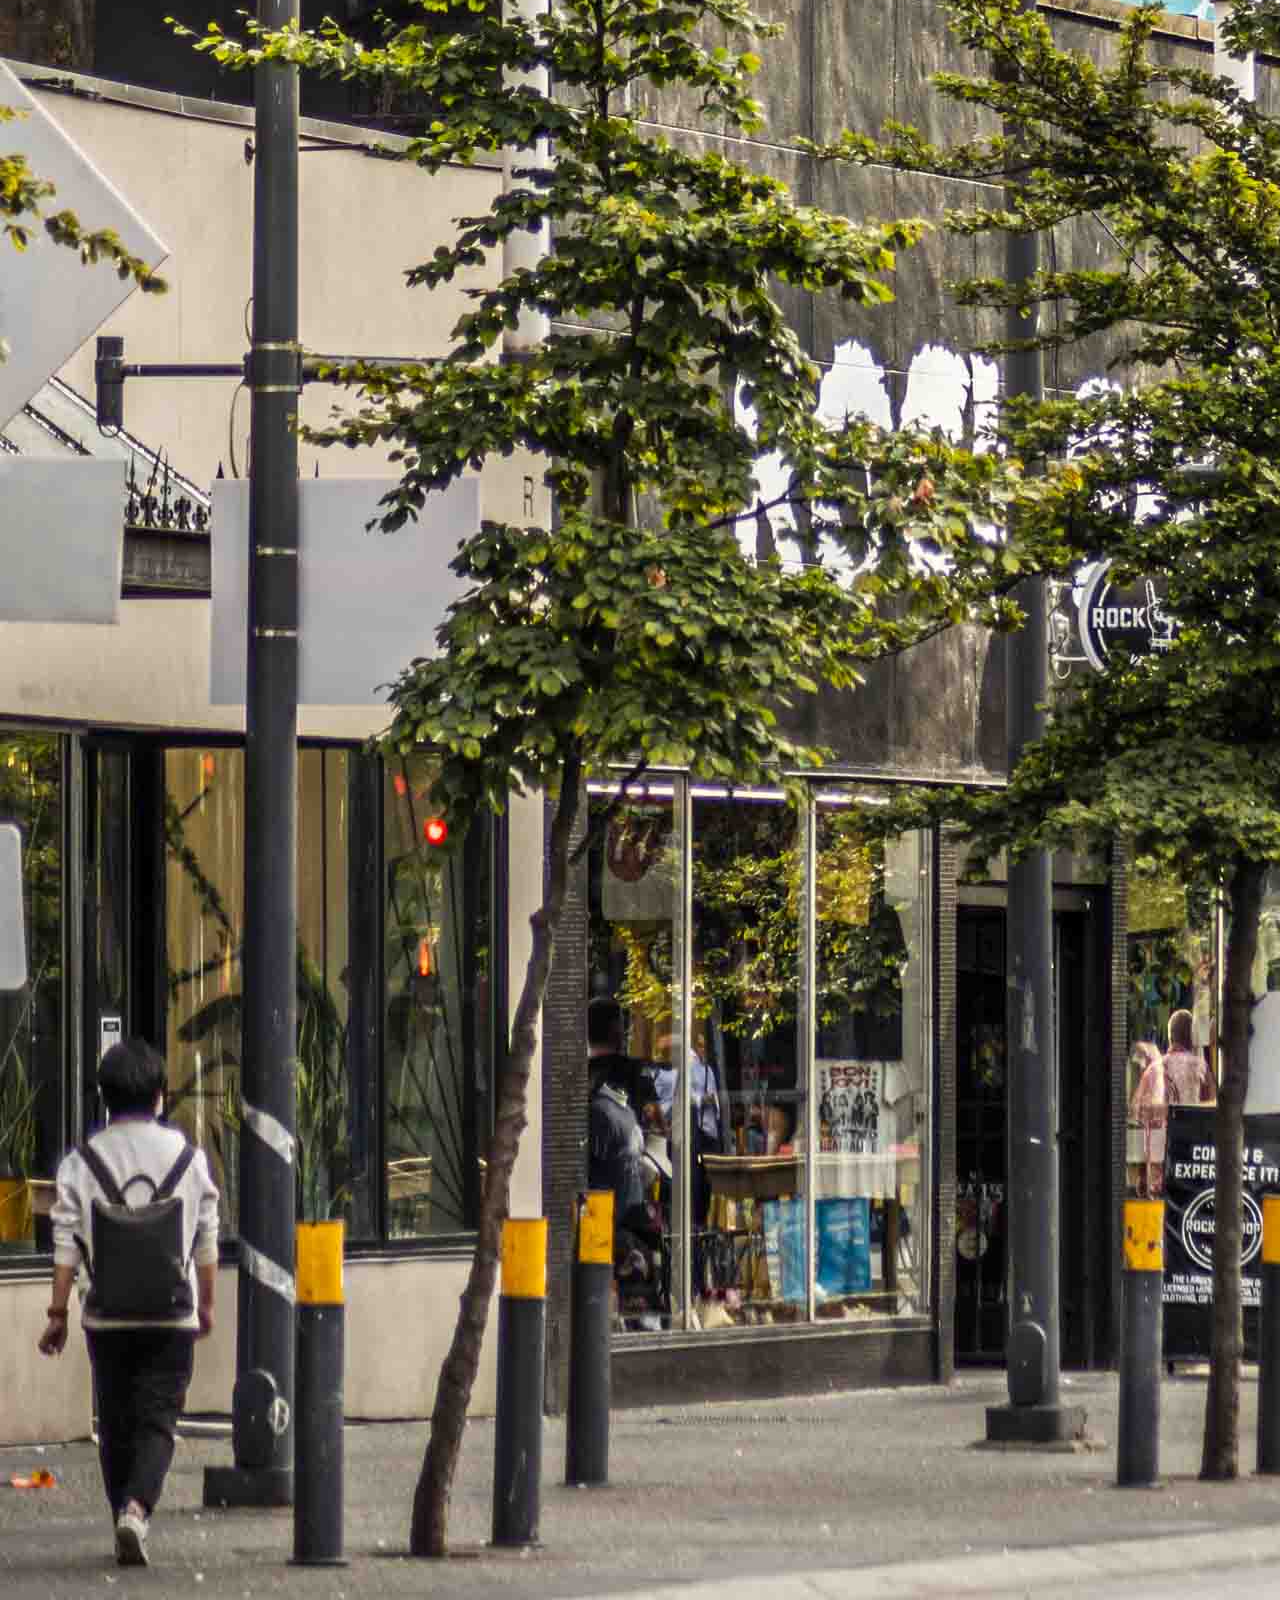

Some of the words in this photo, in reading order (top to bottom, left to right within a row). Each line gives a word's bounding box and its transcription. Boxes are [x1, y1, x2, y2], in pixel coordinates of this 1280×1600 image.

[1092, 607, 1146, 629] ROCK
[1175, 1163, 1257, 1182] EXPERCE
[1260, 1167, 1280, 1182] IT!
